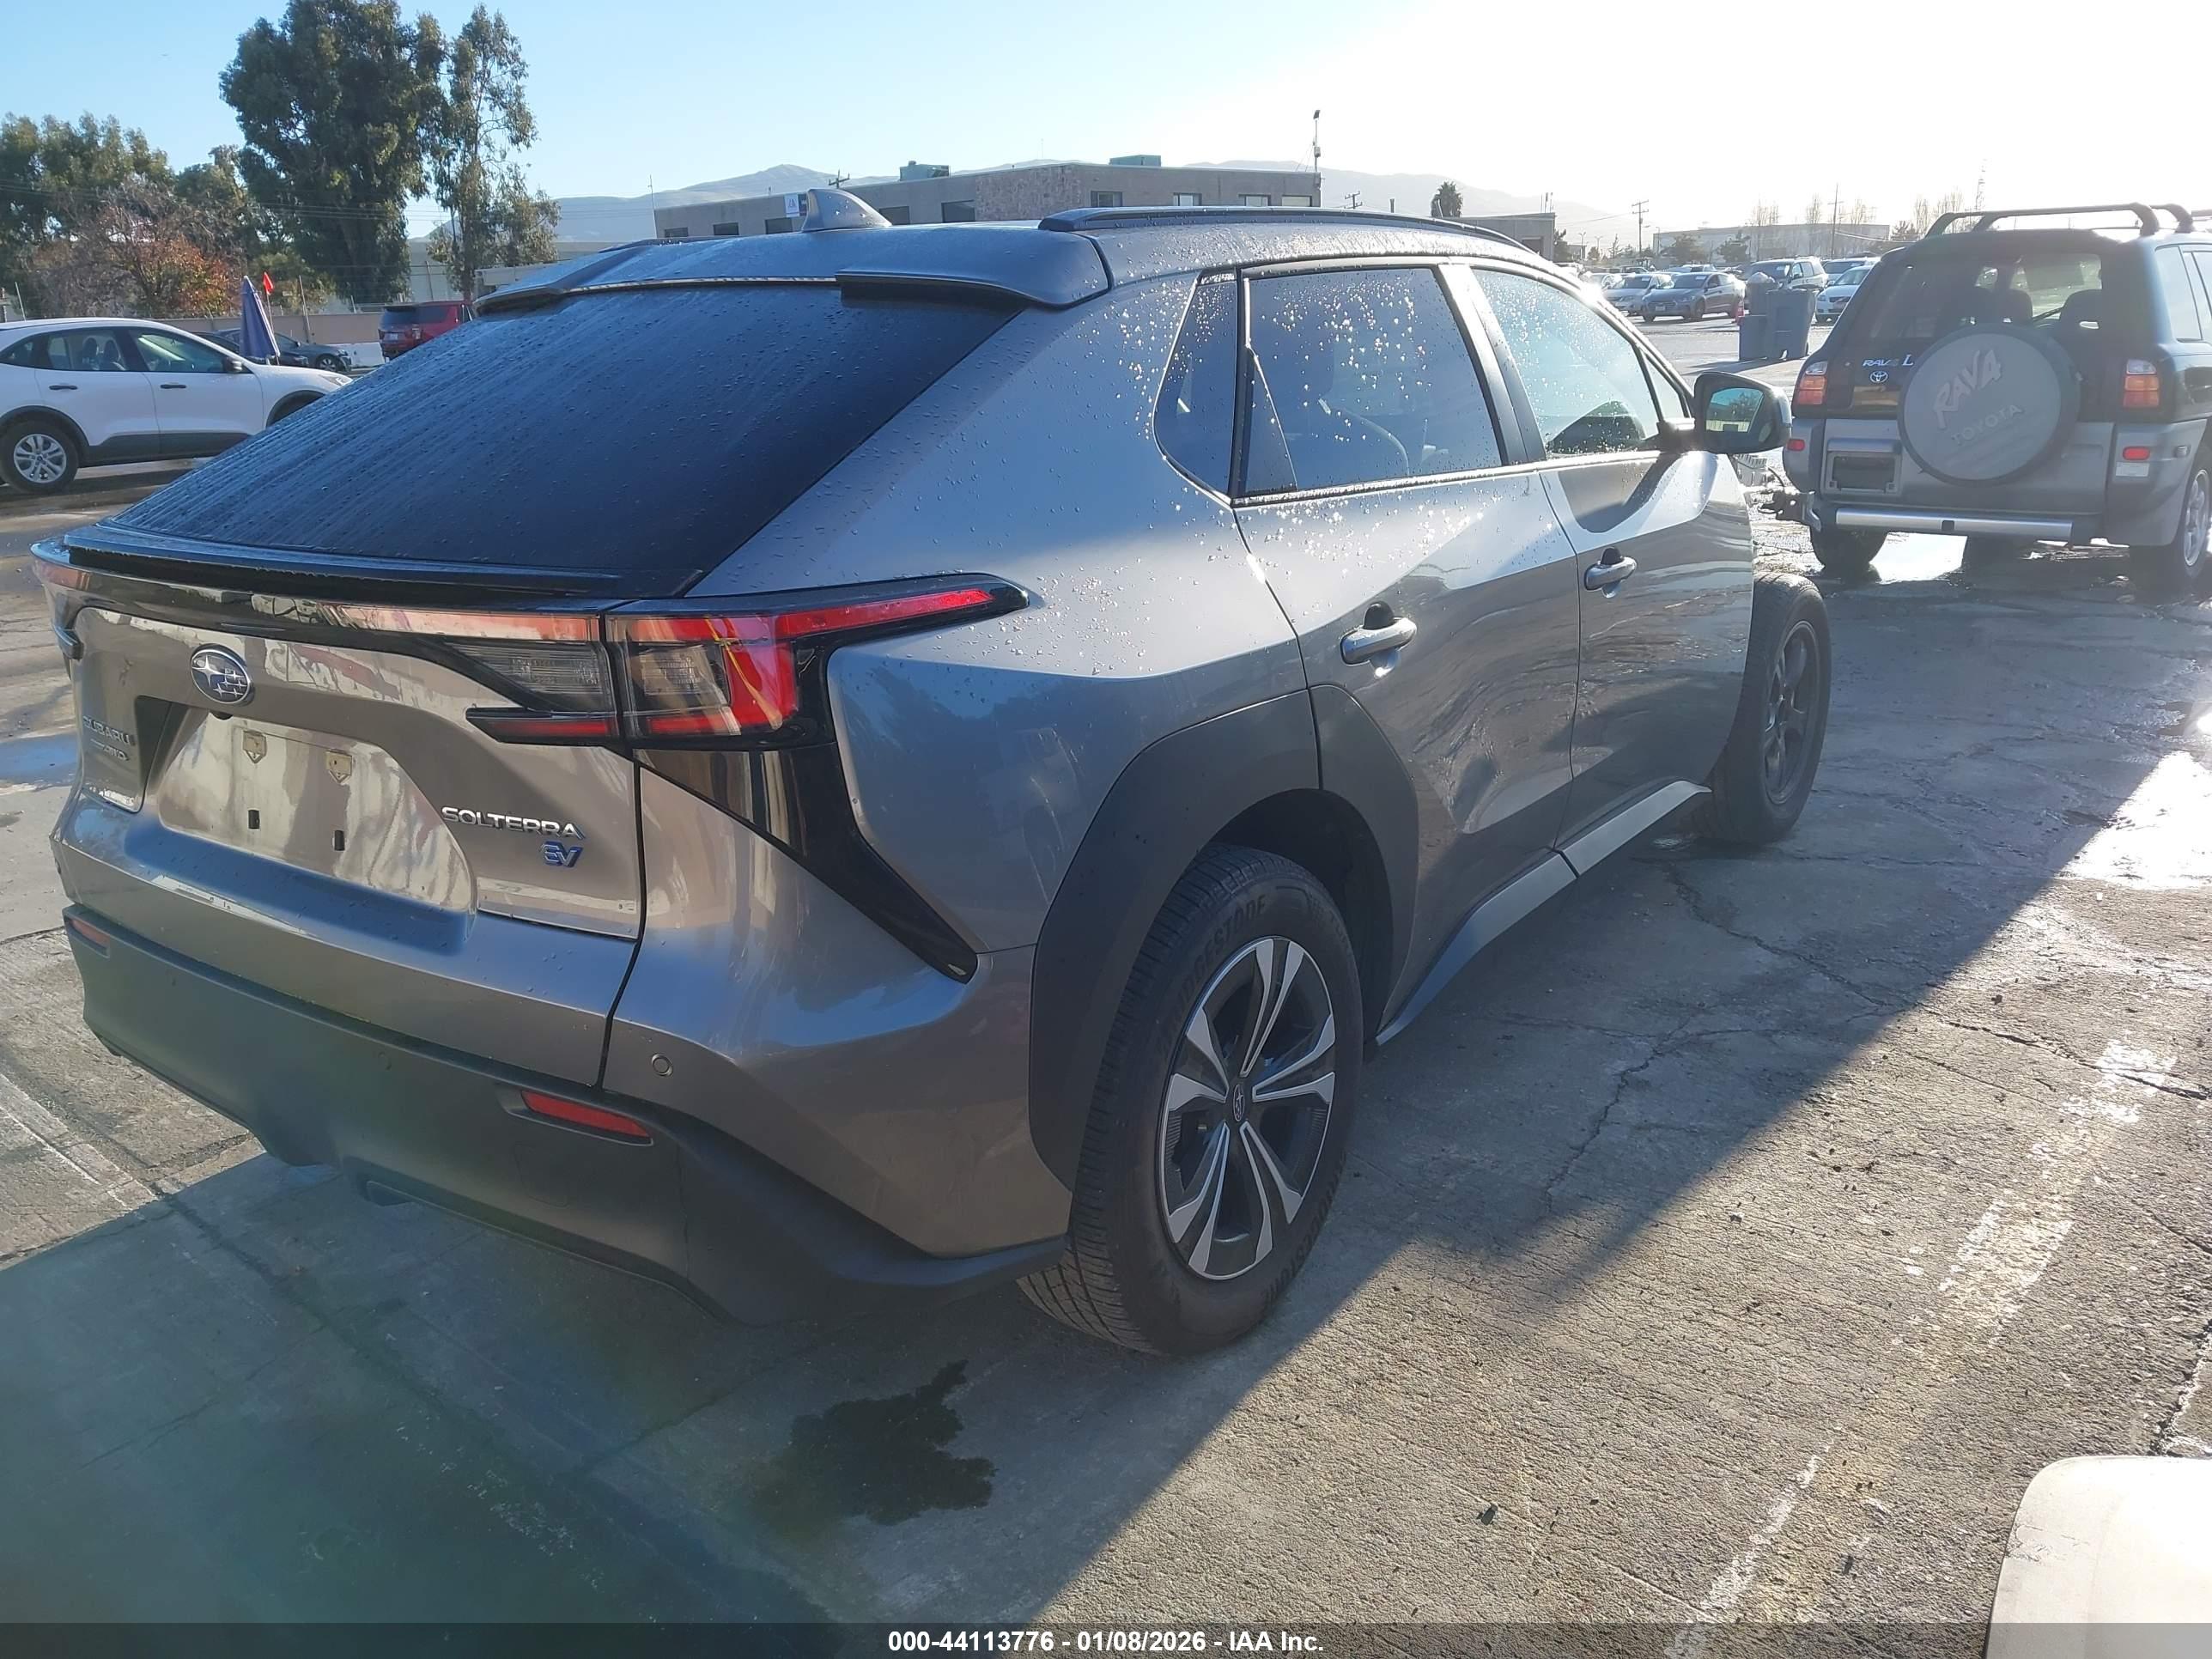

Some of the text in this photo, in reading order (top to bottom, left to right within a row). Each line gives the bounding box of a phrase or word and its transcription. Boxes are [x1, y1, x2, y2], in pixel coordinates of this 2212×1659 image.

[1902, 354, 1914, 366] L
[1933, 349, 2001, 428] RAV4
[1951, 404, 2023, 446] TOYOTA
[82, 715, 133, 746] SUBARU
[441, 806, 586, 840] SOLTERRA
[543, 841, 583, 868] EV
